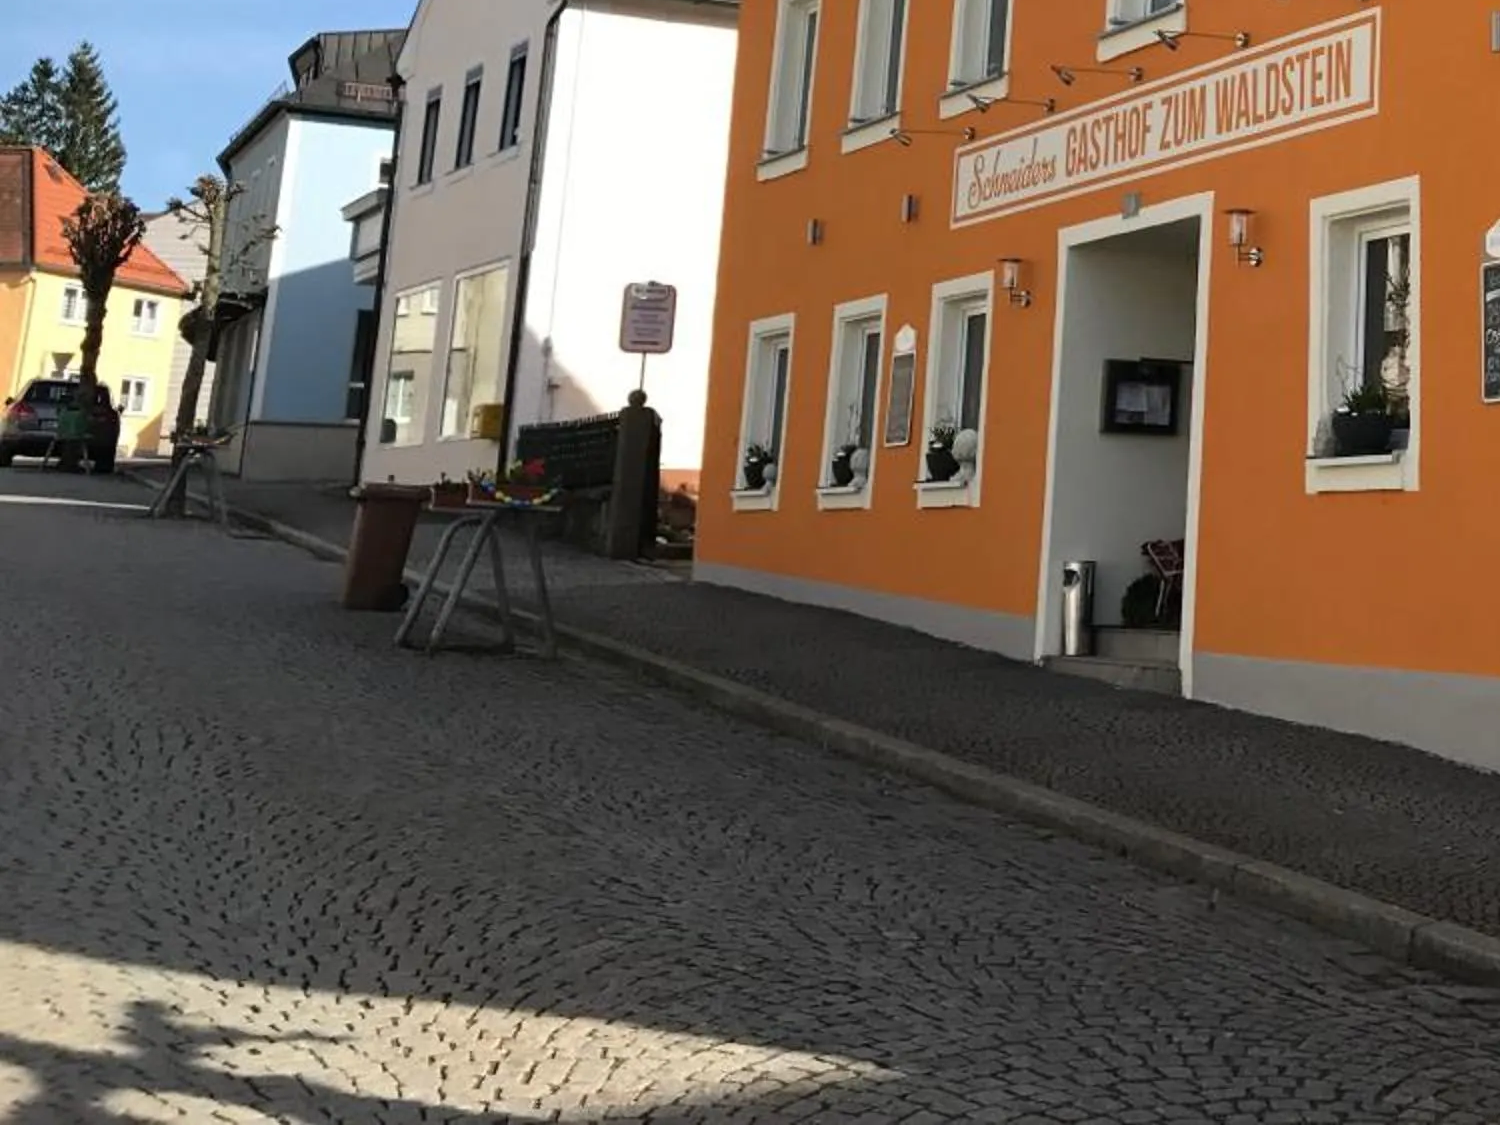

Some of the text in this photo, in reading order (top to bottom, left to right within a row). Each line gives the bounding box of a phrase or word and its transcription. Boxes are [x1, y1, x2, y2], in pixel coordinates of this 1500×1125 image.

[965, 38, 1353, 209] Schneiders GASTHOF ZUM WALDSTEIN
